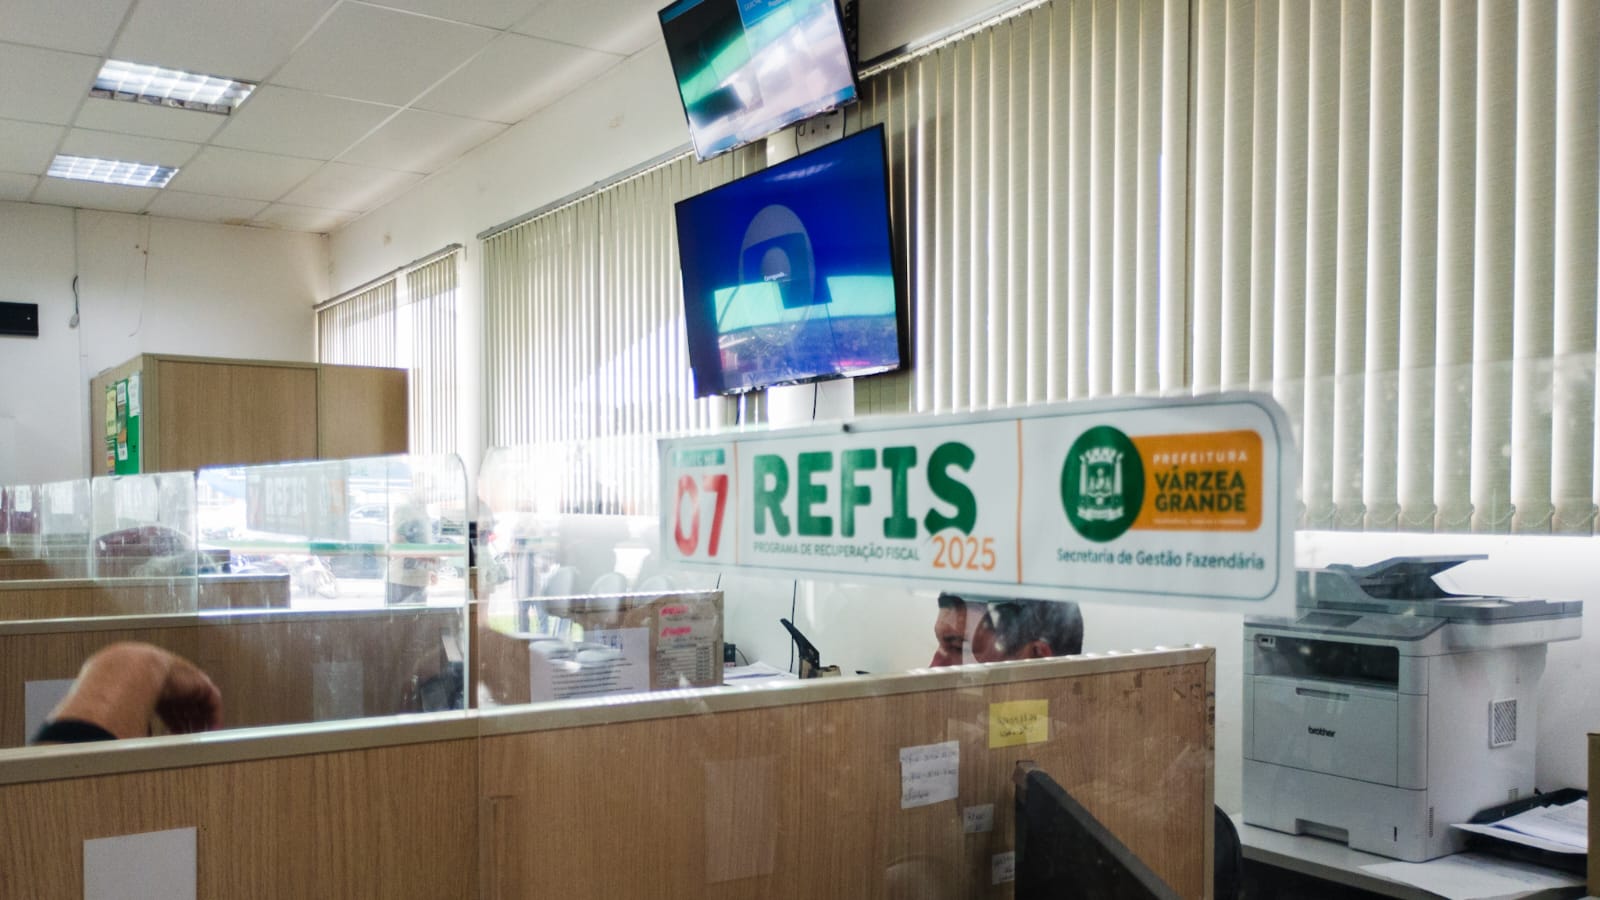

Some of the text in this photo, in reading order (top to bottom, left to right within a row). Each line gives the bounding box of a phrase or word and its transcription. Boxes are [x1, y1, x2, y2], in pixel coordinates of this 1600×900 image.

[1153, 450, 1248, 465] PREFEITURA
[753, 441, 978, 539] REFIS
[1154, 465, 1246, 492] VÁRZEA
[1155, 492, 1247, 513] GRANDE
[674, 473, 729, 558] 07
[753, 541, 920, 562] PROGRAMA DE RECUPERAÇÃO FISCAL
[932, 535, 996, 572] 2025
[1056, 548, 1265, 571] Secretaria de Gestão Fazendária
[1308, 724, 1337, 738] brother
